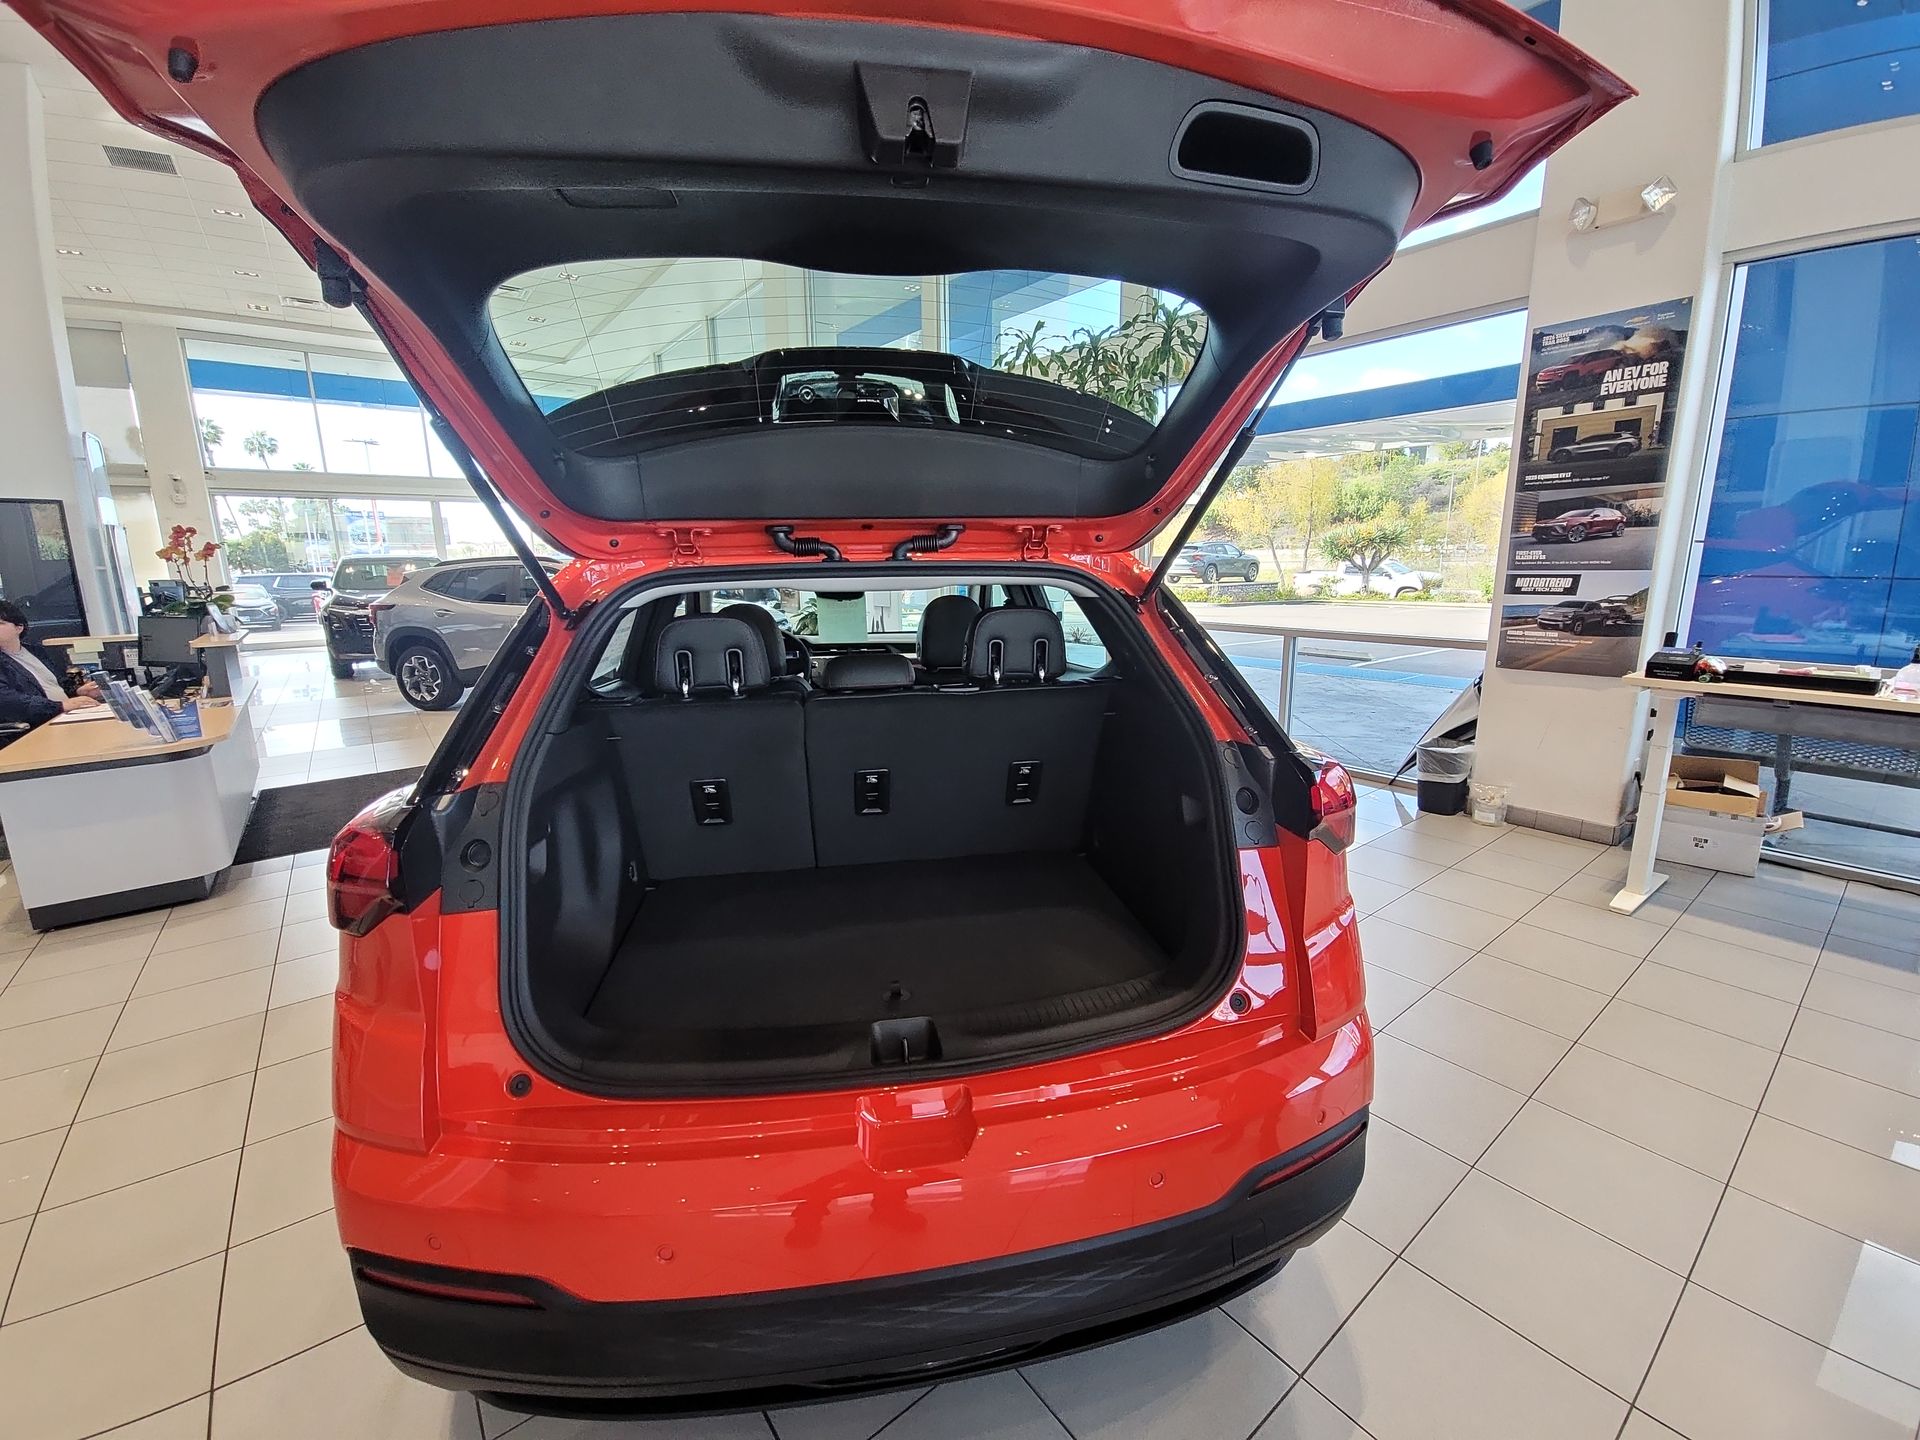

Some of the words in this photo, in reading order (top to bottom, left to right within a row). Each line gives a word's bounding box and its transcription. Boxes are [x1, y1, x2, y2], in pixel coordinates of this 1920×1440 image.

[1603, 369, 1623, 383] AN
[1623, 365, 1642, 380] EV
[1642, 361, 1670, 377] FOR
[1600, 373, 1668, 396] EVERYONE
[1515, 577, 1573, 588] MOTORTREND
